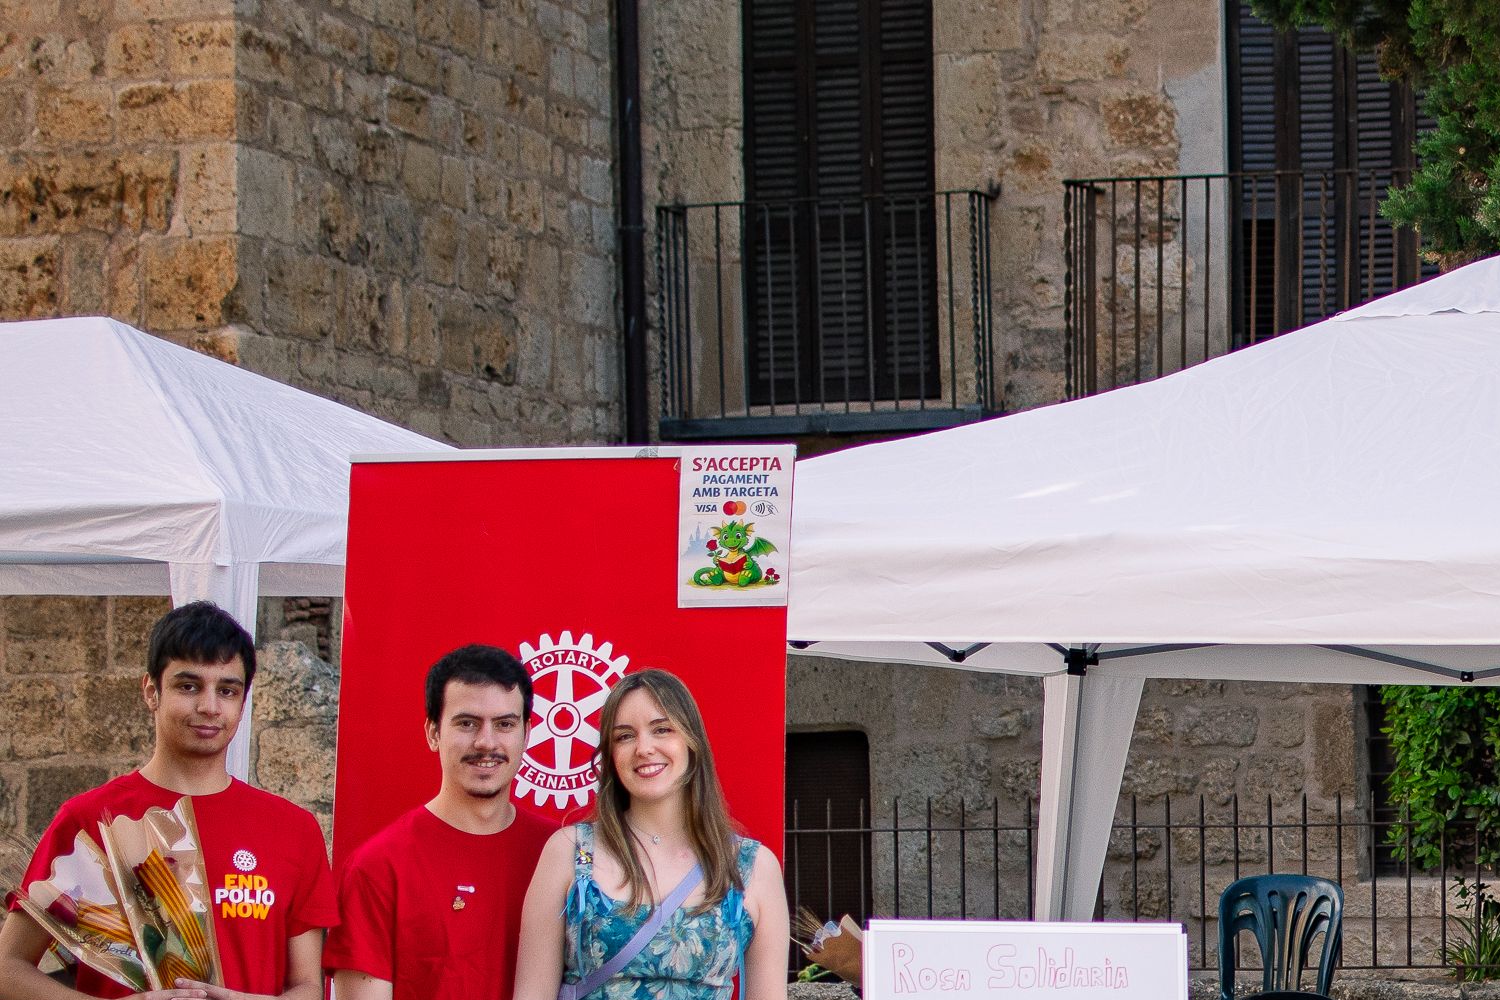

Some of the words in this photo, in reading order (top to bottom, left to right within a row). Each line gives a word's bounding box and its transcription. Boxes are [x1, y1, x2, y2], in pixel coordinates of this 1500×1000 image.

[692, 457, 782, 472] S'ACCEPTA
[702, 474, 770, 485] PAGAMENT
[692, 487, 721, 498] AMB
[723, 486, 779, 497] TARGETA
[694, 504, 718, 513] VISA
[530, 650, 602, 672] ROTARY
[224, 874, 268, 891] END
[215, 888, 275, 906] POLIO
[222, 901, 271, 920] NOW
